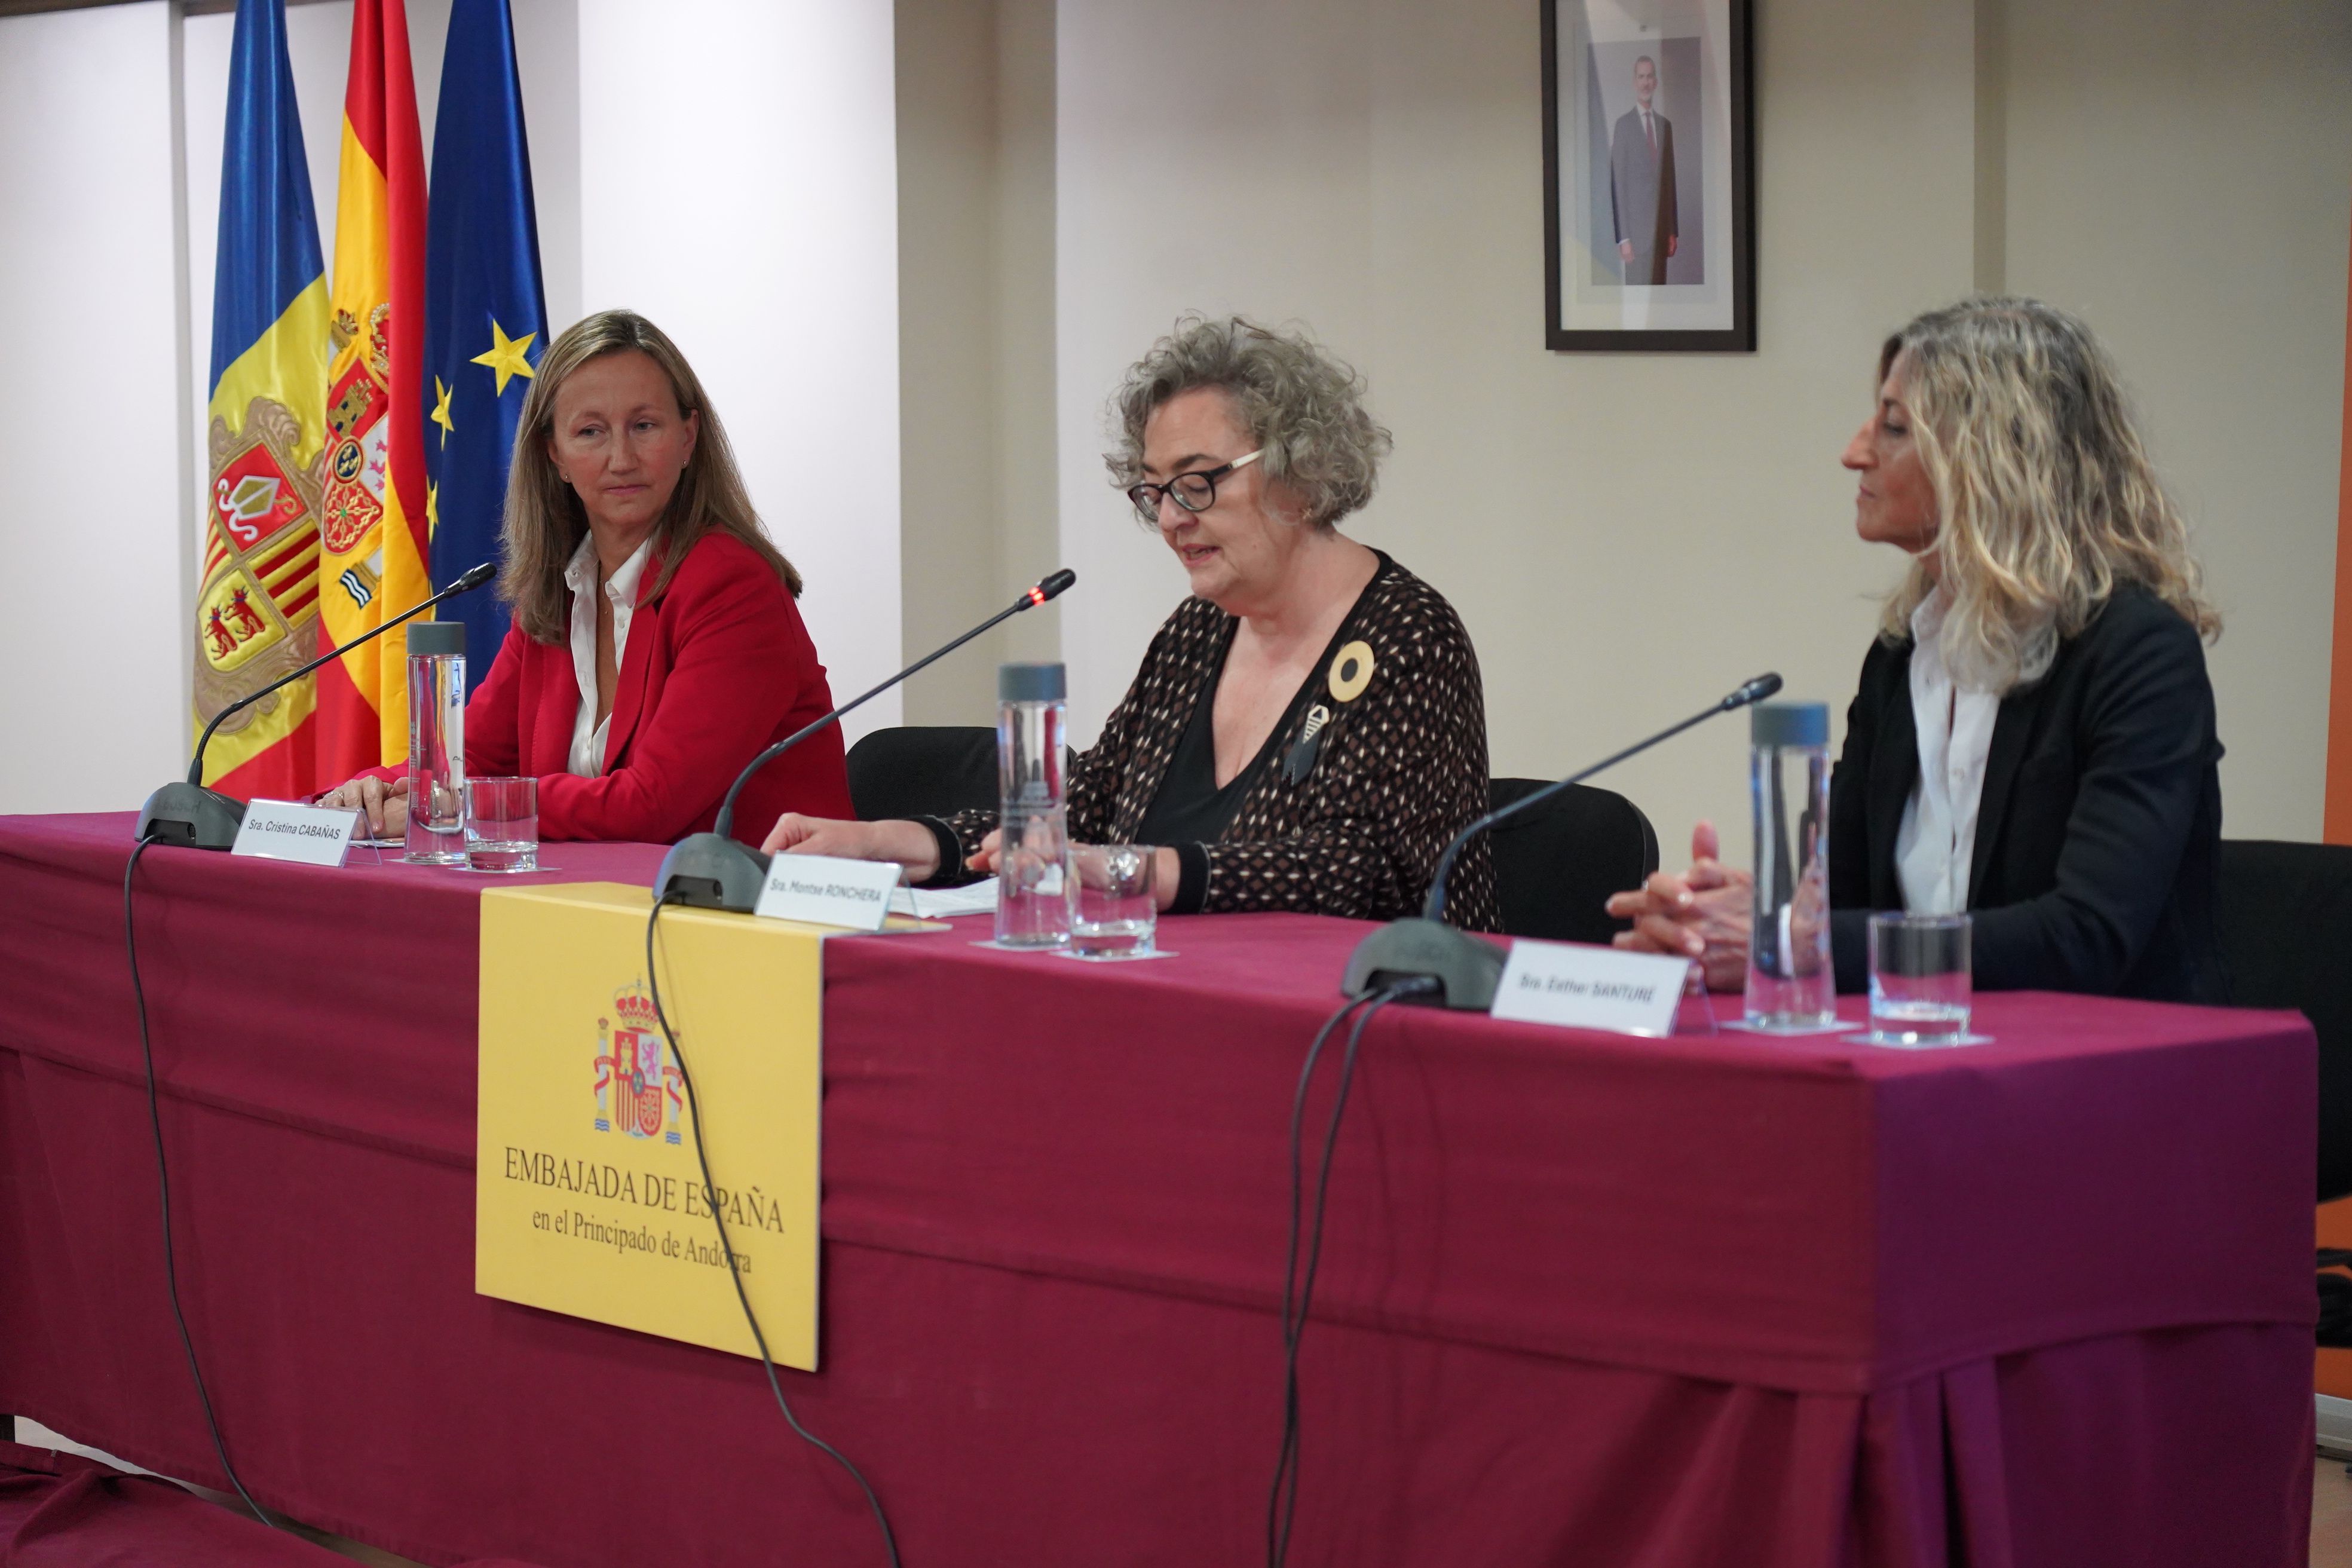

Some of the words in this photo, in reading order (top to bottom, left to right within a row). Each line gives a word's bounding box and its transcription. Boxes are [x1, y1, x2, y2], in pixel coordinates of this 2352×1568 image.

[249, 819, 263, 831] Sra.
[266, 821, 297, 834] Cristina
[299, 825, 341, 840] CABAÑAS
[505, 1146, 638, 1203] EMBAJADA
[644, 1173, 676, 1211] DE
[685, 1181, 784, 1233] ESPAÑA
[532, 1210, 550, 1231] en
[555, 1209, 568, 1235] el
[573, 1212, 656, 1254] Principado
[662, 1230, 680, 1258] de
[684, 1236, 751, 1273] Andora
